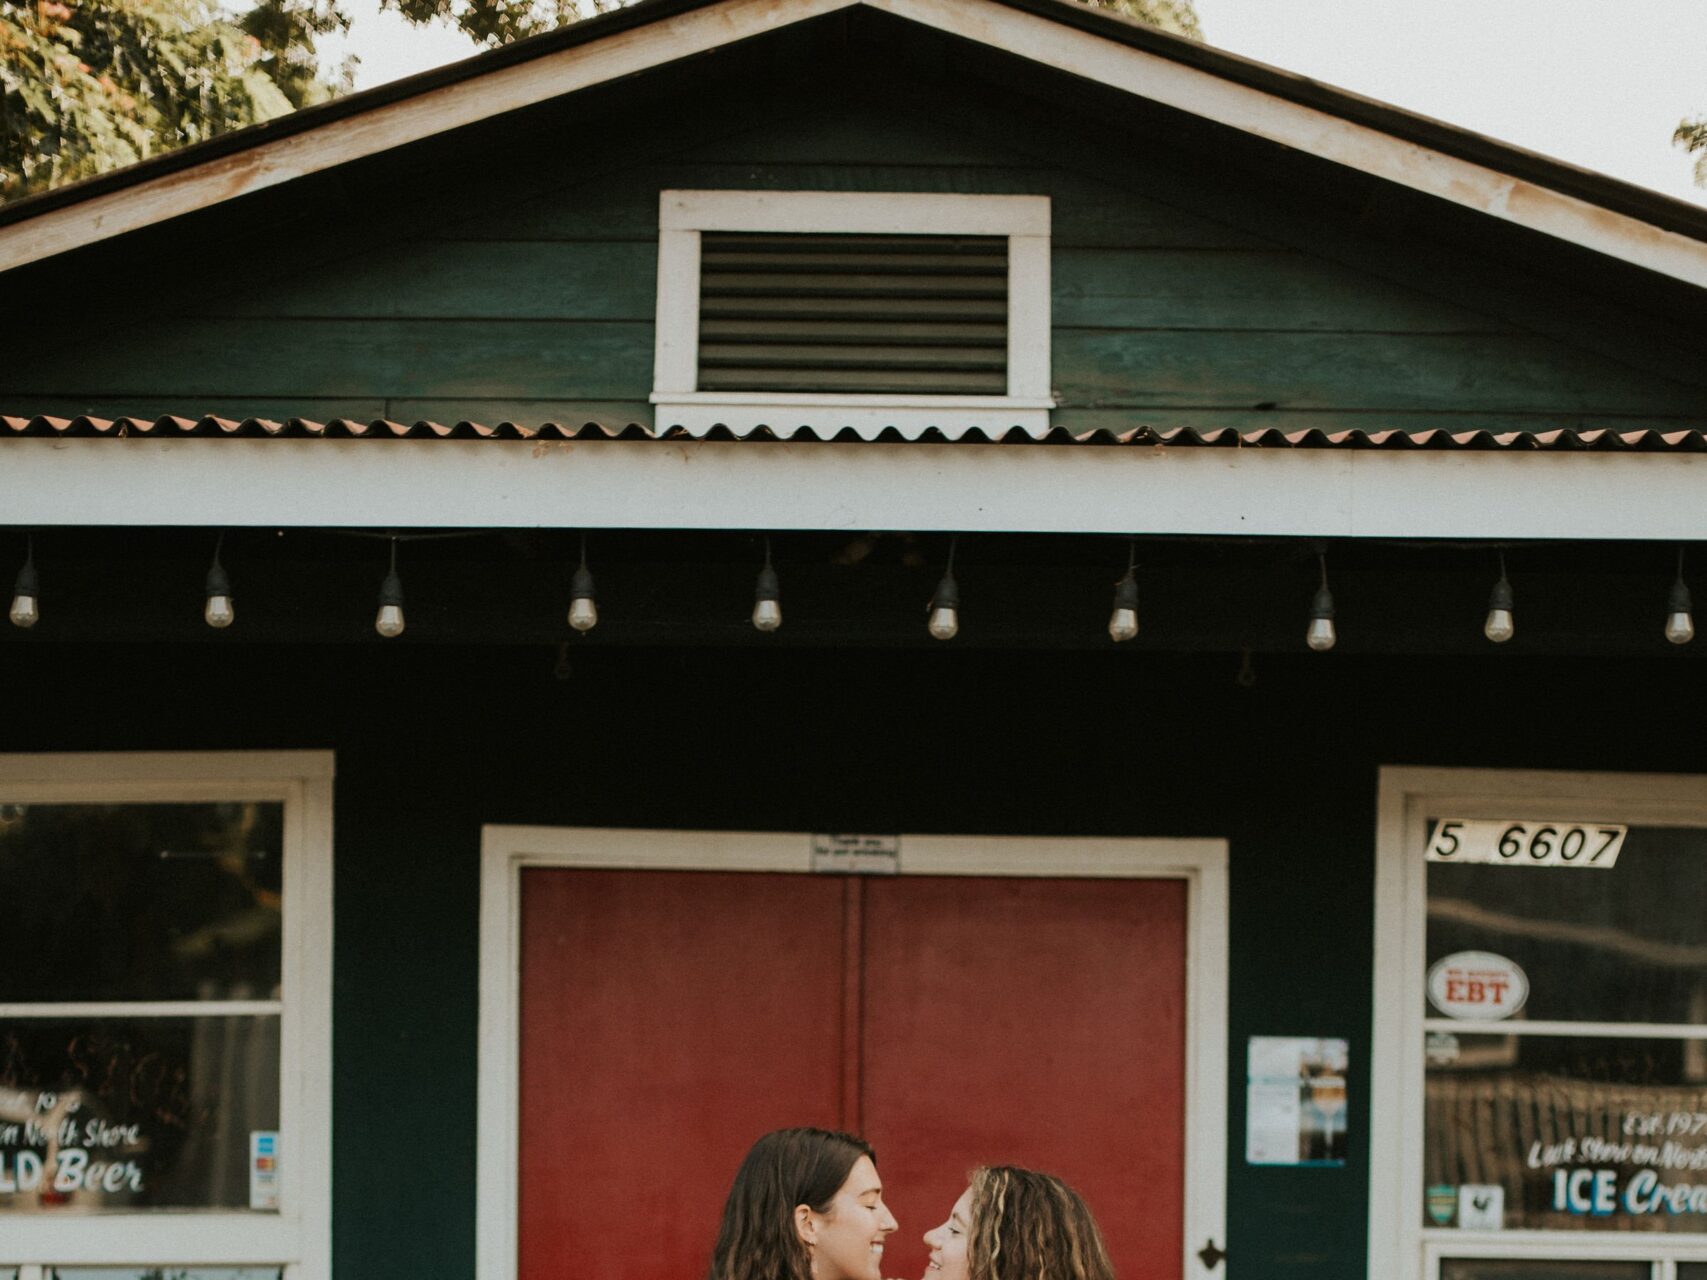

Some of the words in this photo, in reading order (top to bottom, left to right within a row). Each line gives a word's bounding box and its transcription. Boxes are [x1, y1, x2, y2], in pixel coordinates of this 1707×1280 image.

[1435, 823, 1464, 856] 5
[1498, 826, 1621, 862] 6607
[1446, 980, 1509, 1005] EBT
[53, 1148, 145, 1193] Beer
[1552, 1168, 1617, 1216] ICE
